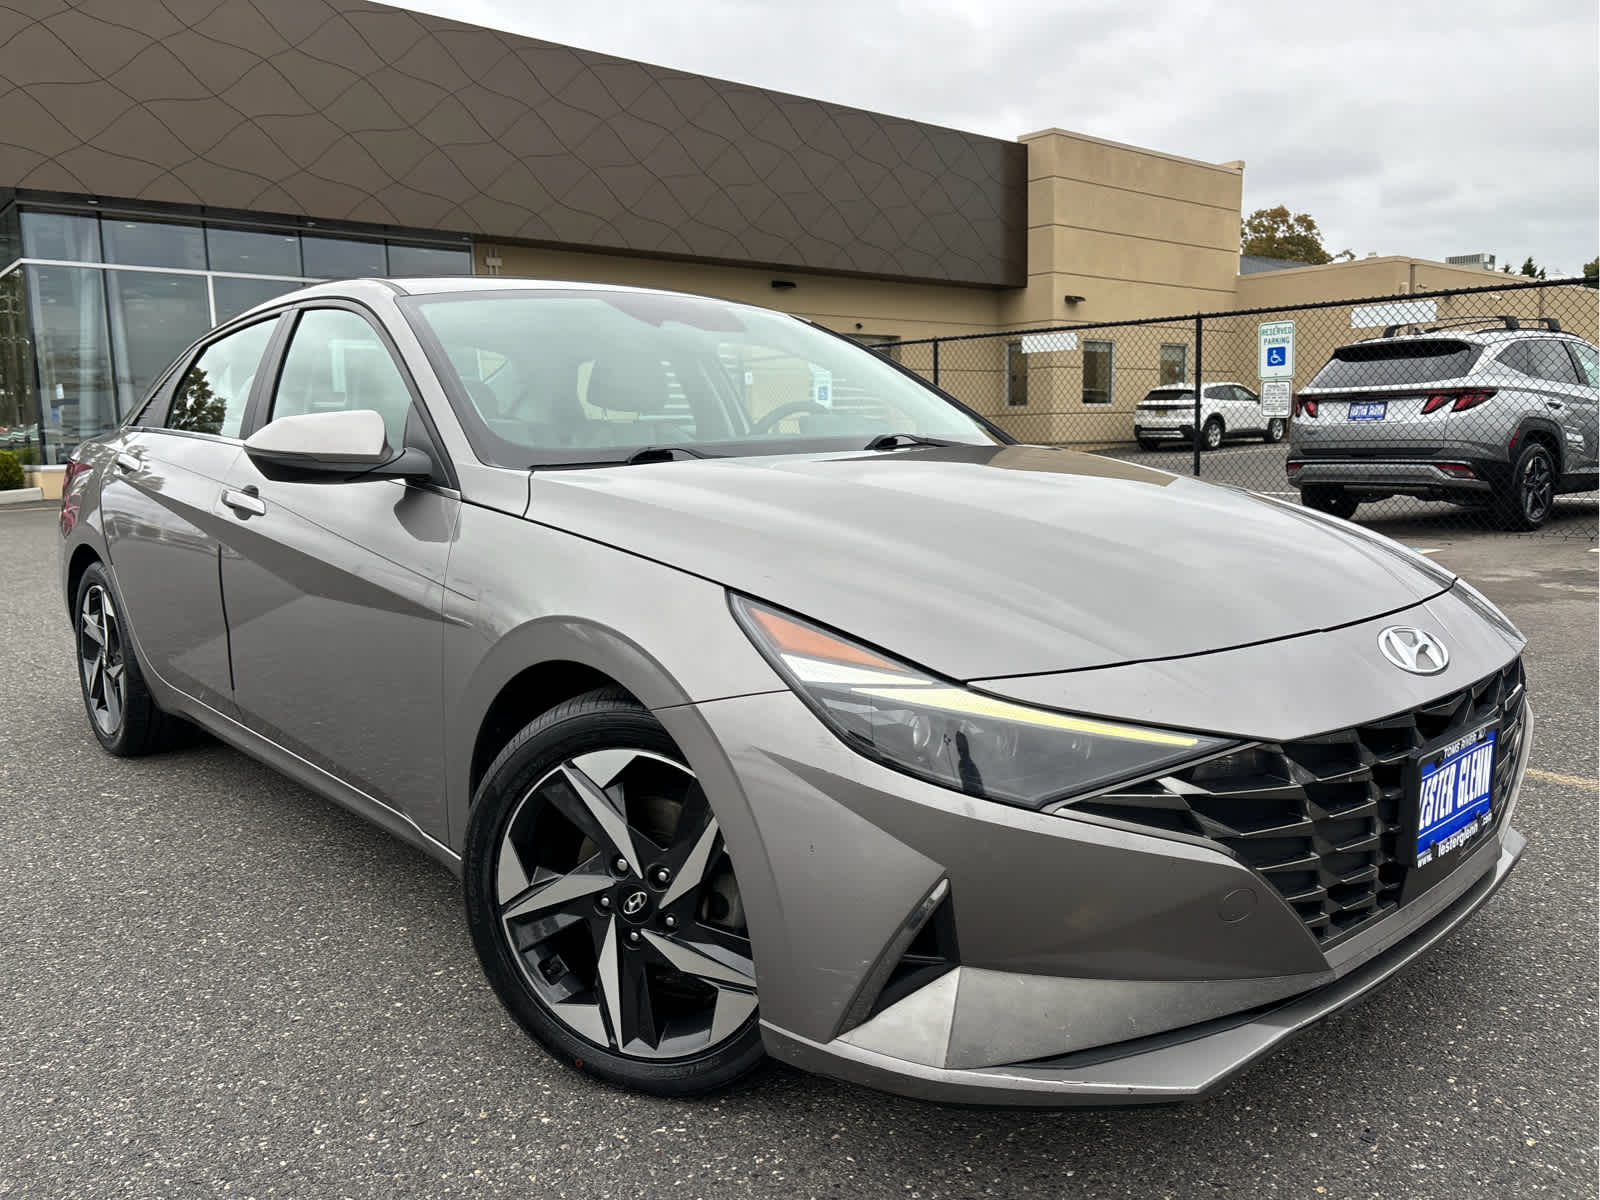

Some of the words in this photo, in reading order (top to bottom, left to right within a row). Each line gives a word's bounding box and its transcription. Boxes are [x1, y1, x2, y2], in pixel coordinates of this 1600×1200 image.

[1419, 763, 1457, 831] LESTER
[1457, 744, 1493, 809] GLENN
[1438, 822, 1478, 858] lesterglenn
